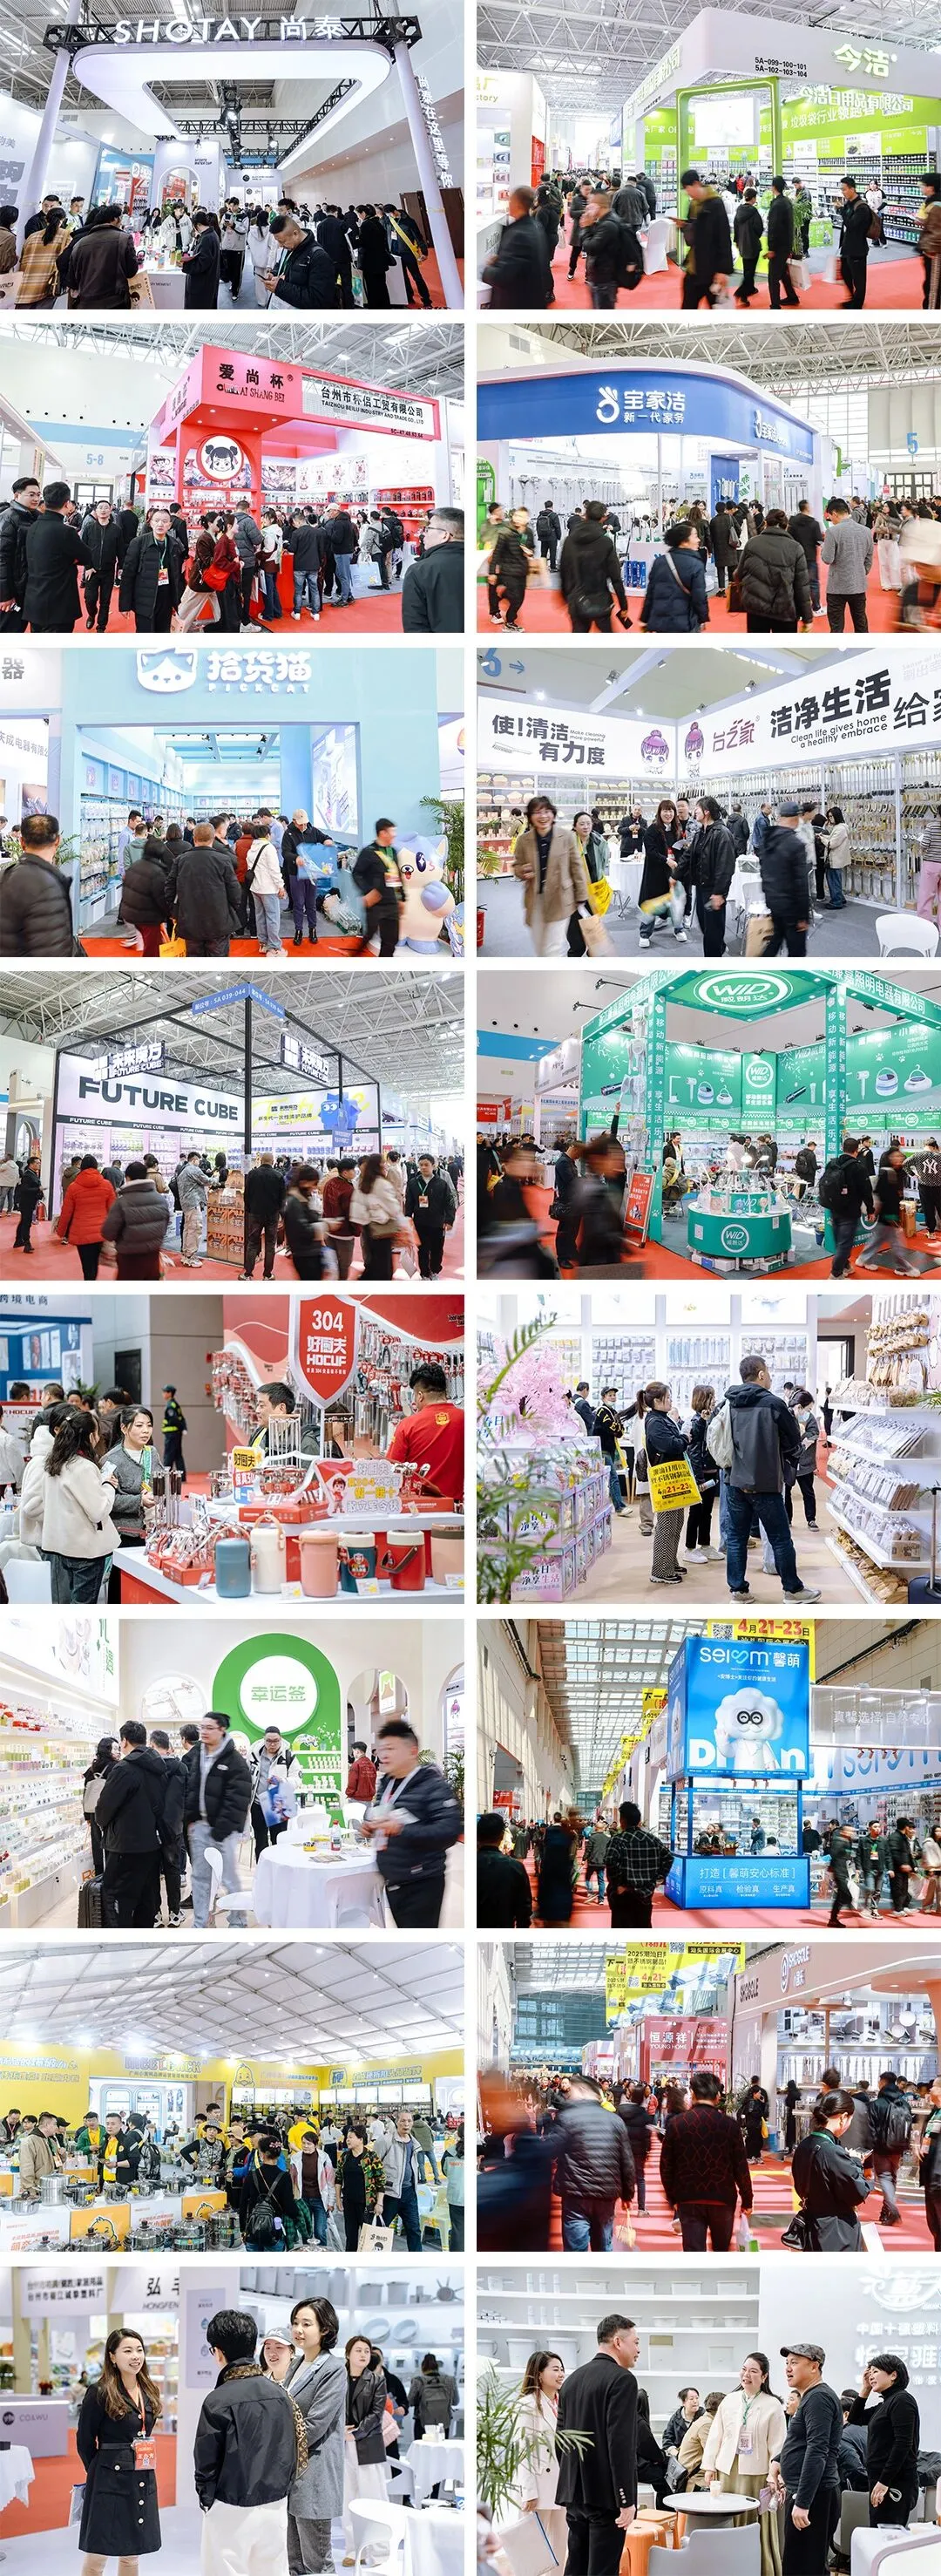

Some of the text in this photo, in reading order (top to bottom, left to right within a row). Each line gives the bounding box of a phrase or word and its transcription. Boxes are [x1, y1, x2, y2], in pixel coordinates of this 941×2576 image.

[113, 15, 345, 44] SHOTAY 尚泰
[755, 57, 807, 71] 5A-099-100-101
[833, 44, 890, 78] 今洁
[755, 65, 808, 78] 5A-102-103-104
[417, 76, 453, 188] 尚泰在这里等你
[219, 363, 284, 390] 爱尚杯
[250, 388, 273, 401] SHANG
[321, 386, 423, 418] 台州市杯侣工贸有限公司
[623, 389, 686, 411] 宝家洁
[322, 400, 344, 410] TAIZHOU
[623, 412, 685, 424] 新一代家务
[906, 432, 918, 454] 5
[86, 452, 105, 466] 5-8
[1, 657, 25, 680] 器
[206, 650, 312, 684] 拾货猫
[208, 683, 310, 694] PICKCAT
[770, 669, 891, 738] 洁净生活
[586, 731, 606, 739] cleaning
[791, 714, 888, 744] Clean life gives home
[808, 734, 838, 748] healthy
[841, 722, 888, 739] embrace
[538, 740, 606, 765] 有力度
[712, 982, 772, 996] WID
[113, 1059, 163, 1078] FUTURE CUBE
[751, 1066, 768, 1076] WID
[79, 1076, 239, 1120] FUTURE CUBE
[726, 1230, 744, 1240] WID
[0, 1295, 48, 1306] 跨境电商
[311, 1309, 344, 1332] 304
[307, 1335, 347, 1355] 好厨夫
[306, 1354, 347, 1367] HOCUF
[234, 1452, 255, 1467] 好厨夫
[773, 1653, 801, 1669] 馨萌
[251, 1685, 307, 1703] 幸运签
[735, 1885, 760, 1893] 检验真
[772, 1885, 795, 1893] 生产真
[650, 2031, 687, 2043] 恒源祥
